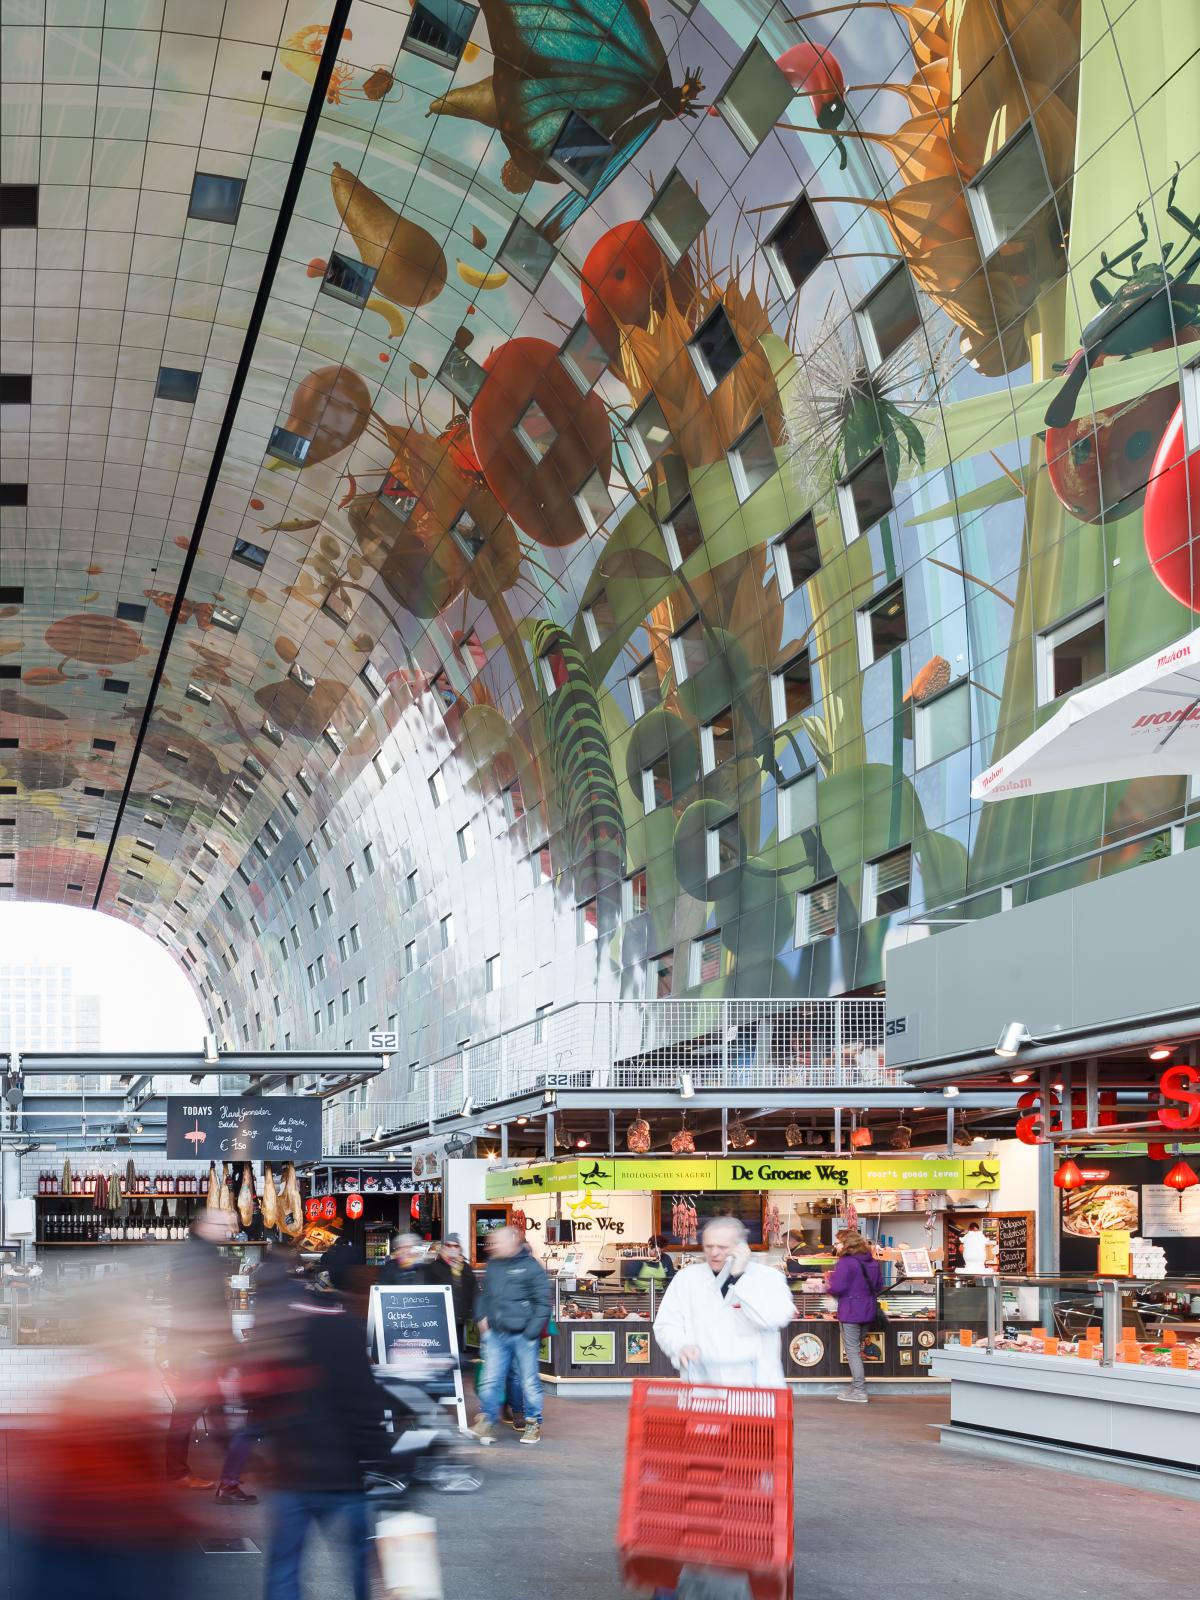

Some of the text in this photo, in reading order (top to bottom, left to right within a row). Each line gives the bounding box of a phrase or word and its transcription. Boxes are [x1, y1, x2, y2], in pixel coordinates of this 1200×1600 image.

[886, 1018, 906, 1036] 35
[371, 1034, 396, 1048] 52
[548, 1074, 568, 1086] 32
[182, 1106, 213, 1116] TODAYS
[731, 1165, 849, 1186] De Groene Weg
[525, 1218, 541, 1230] De
[596, 1218, 625, 1234] Weg
